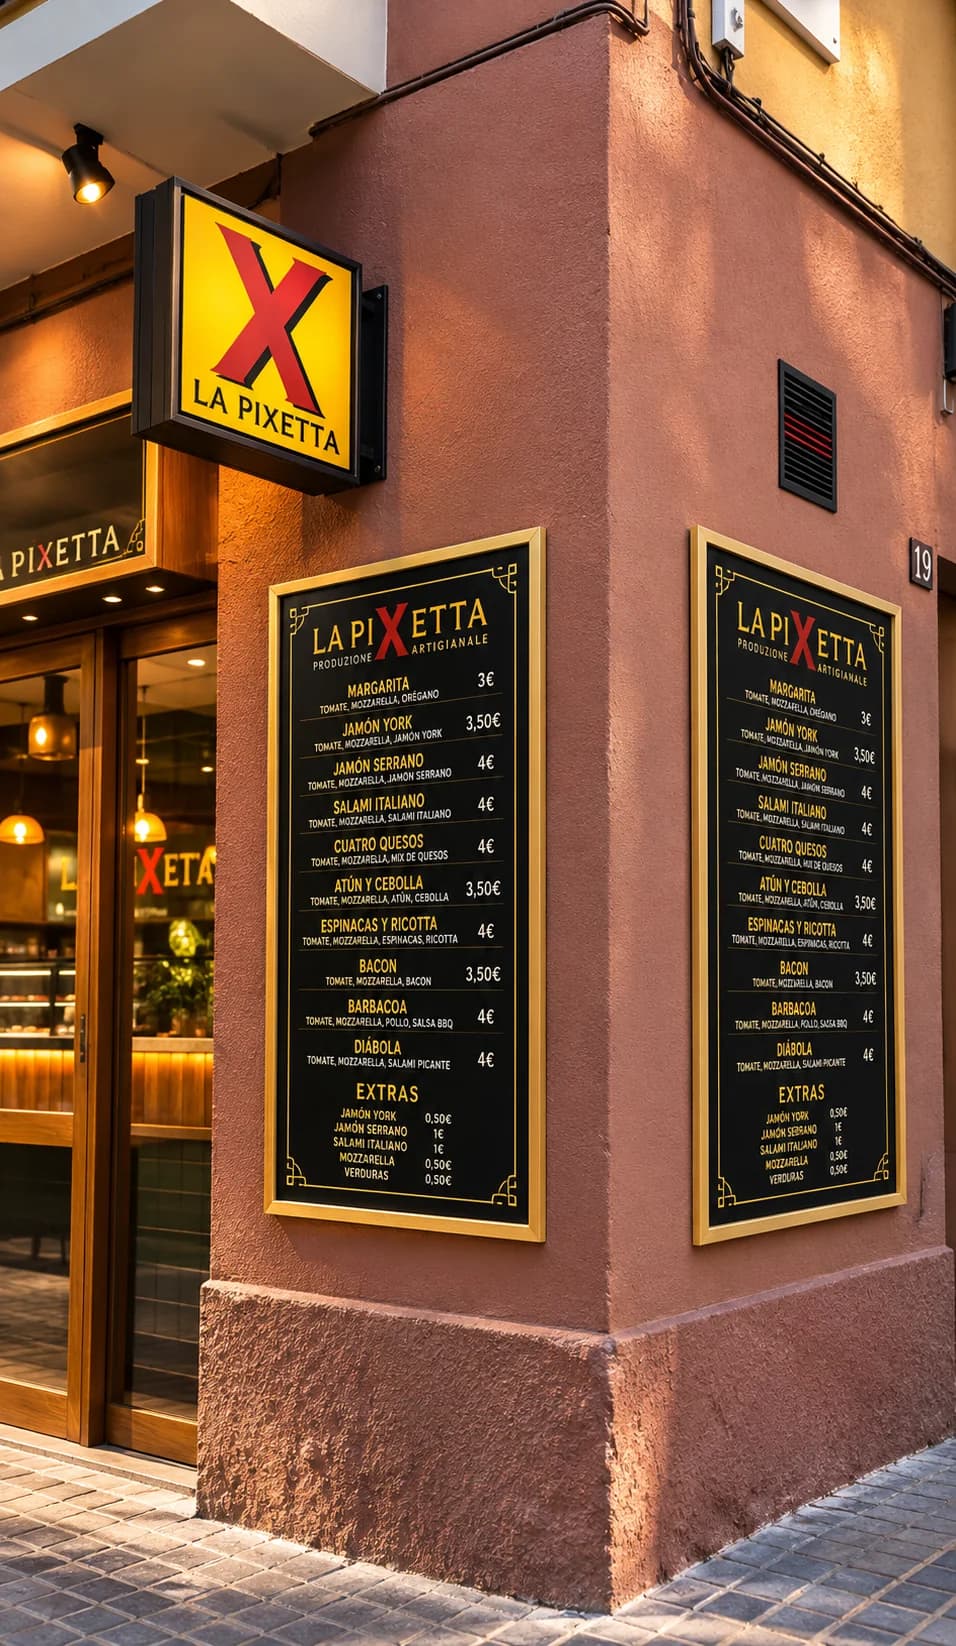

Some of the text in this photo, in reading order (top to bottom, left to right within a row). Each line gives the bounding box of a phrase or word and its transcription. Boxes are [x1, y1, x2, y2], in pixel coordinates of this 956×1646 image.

[210, 221, 333, 418] X
[193, 378, 340, 456] LA PIXETTA
[11, 524, 120, 578] PIXETTA
[914, 545, 932, 582] 19
[313, 597, 488, 661] LA PIXETTA
[737, 600, 867, 672] LA PIXETTA
[313, 633, 488, 671] PRODUZIONE ARTIGIANALE
[737, 637, 867, 687] PRODUZIONE ARTIGIANALE
[347, 676, 409, 698] MARGARITA
[477, 671, 494, 687] 3€
[769, 678, 816, 705] MARGARITA
[319, 702, 350, 714] TOMATE,
[401, 689, 439, 703] ORÉGANO
[342, 714, 412, 737] JAMÓN YORK
[465, 712, 501, 732] 3,50€
[861, 710, 871, 726] 3€
[764, 717, 818, 743] JAMÓN YORK
[314, 740, 344, 752] TOMATE,
[421, 728, 442, 739] YORK
[333, 752, 424, 776] JAMÓN SERRANO
[477, 754, 494, 770] 4€
[854, 746, 875, 765] 3,50€
[758, 755, 827, 782] JAMÓN SERRANO
[307, 779, 337, 790] TOMATE,
[415, 767, 452, 780] SERRANO
[861, 785, 872, 800] 4€
[333, 792, 425, 815] SALAMI ITALIANO
[477, 796, 494, 812] 4€
[758, 794, 827, 820] SALAMI ITALIANO
[308, 817, 338, 828] TOMATE,
[387, 811, 415, 823] SALAMI
[416, 808, 451, 820] ITALIANO
[861, 821, 873, 836] 4€
[333, 833, 424, 853] CUATRO QUESOS
[477, 838, 494, 854] 4€
[759, 835, 827, 858] CUATRO QUESOS
[310, 856, 340, 867] TOMATE,
[390, 852, 405, 862] MIX
[406, 851, 416, 862] DE
[417, 849, 449, 862] QUESOS
[861, 858, 873, 873] 4€
[334, 874, 423, 893] ATÚN Y CEBOLLA
[466, 880, 501, 898] 3,50€
[759, 874, 827, 897] ATÚN Y CEBOLLA
[309, 895, 340, 906] TOMATE,
[390, 891, 413, 904] ATÚN,
[414, 892, 449, 902] CEBOLLA
[854, 894, 876, 911] 3,50€
[321, 915, 437, 933] ESPINACAS Y RICOTTA
[477, 923, 494, 939] 4€
[747, 916, 836, 937] ESPINACAS Y RICOTTA
[302, 936, 332, 946] TOMATE,
[425, 933, 458, 944] RICOTTA
[862, 933, 873, 947] 4€
[359, 958, 397, 973] BACON
[465, 966, 501, 983] 3,50€
[780, 960, 808, 976] BACON
[325, 976, 355, 987] TOMATE,
[405, 976, 432, 986] BACON
[855, 970, 877, 987] 3,50€
[347, 998, 407, 1014] BARBACOA
[771, 1001, 816, 1016] BARBACOA
[305, 1016, 335, 1027] TOMATE,
[385, 1017, 411, 1028] POLLO,
[412, 1017, 436, 1028] SALSA
[437, 1018, 453, 1030] BBQ
[477, 1008, 494, 1024] 4€
[862, 1009, 874, 1023] 4€
[354, 1035, 402, 1055] DIÁBOLA
[776, 1039, 812, 1057] DIÁBOLA
[862, 1047, 874, 1061] 4€
[306, 1055, 337, 1066] TOMATE,
[387, 1058, 416, 1068] SALAMI
[417, 1059, 451, 1070] PICANTE
[477, 1051, 494, 1067] 4€
[356, 1082, 418, 1103] EXTRAS
[778, 1083, 825, 1103] EXTRAS
[340, 1106, 452, 1124] JAMÓN YORK 0,50€
[333, 1120, 444, 1139] JAMÓN SERRANO 1€
[333, 1136, 444, 1154] SALAMI ITALIANO 1€
[339, 1151, 452, 1171] MOZZARELLA 0,50€
[344, 1166, 452, 1186] VERDURAS 0,50€
